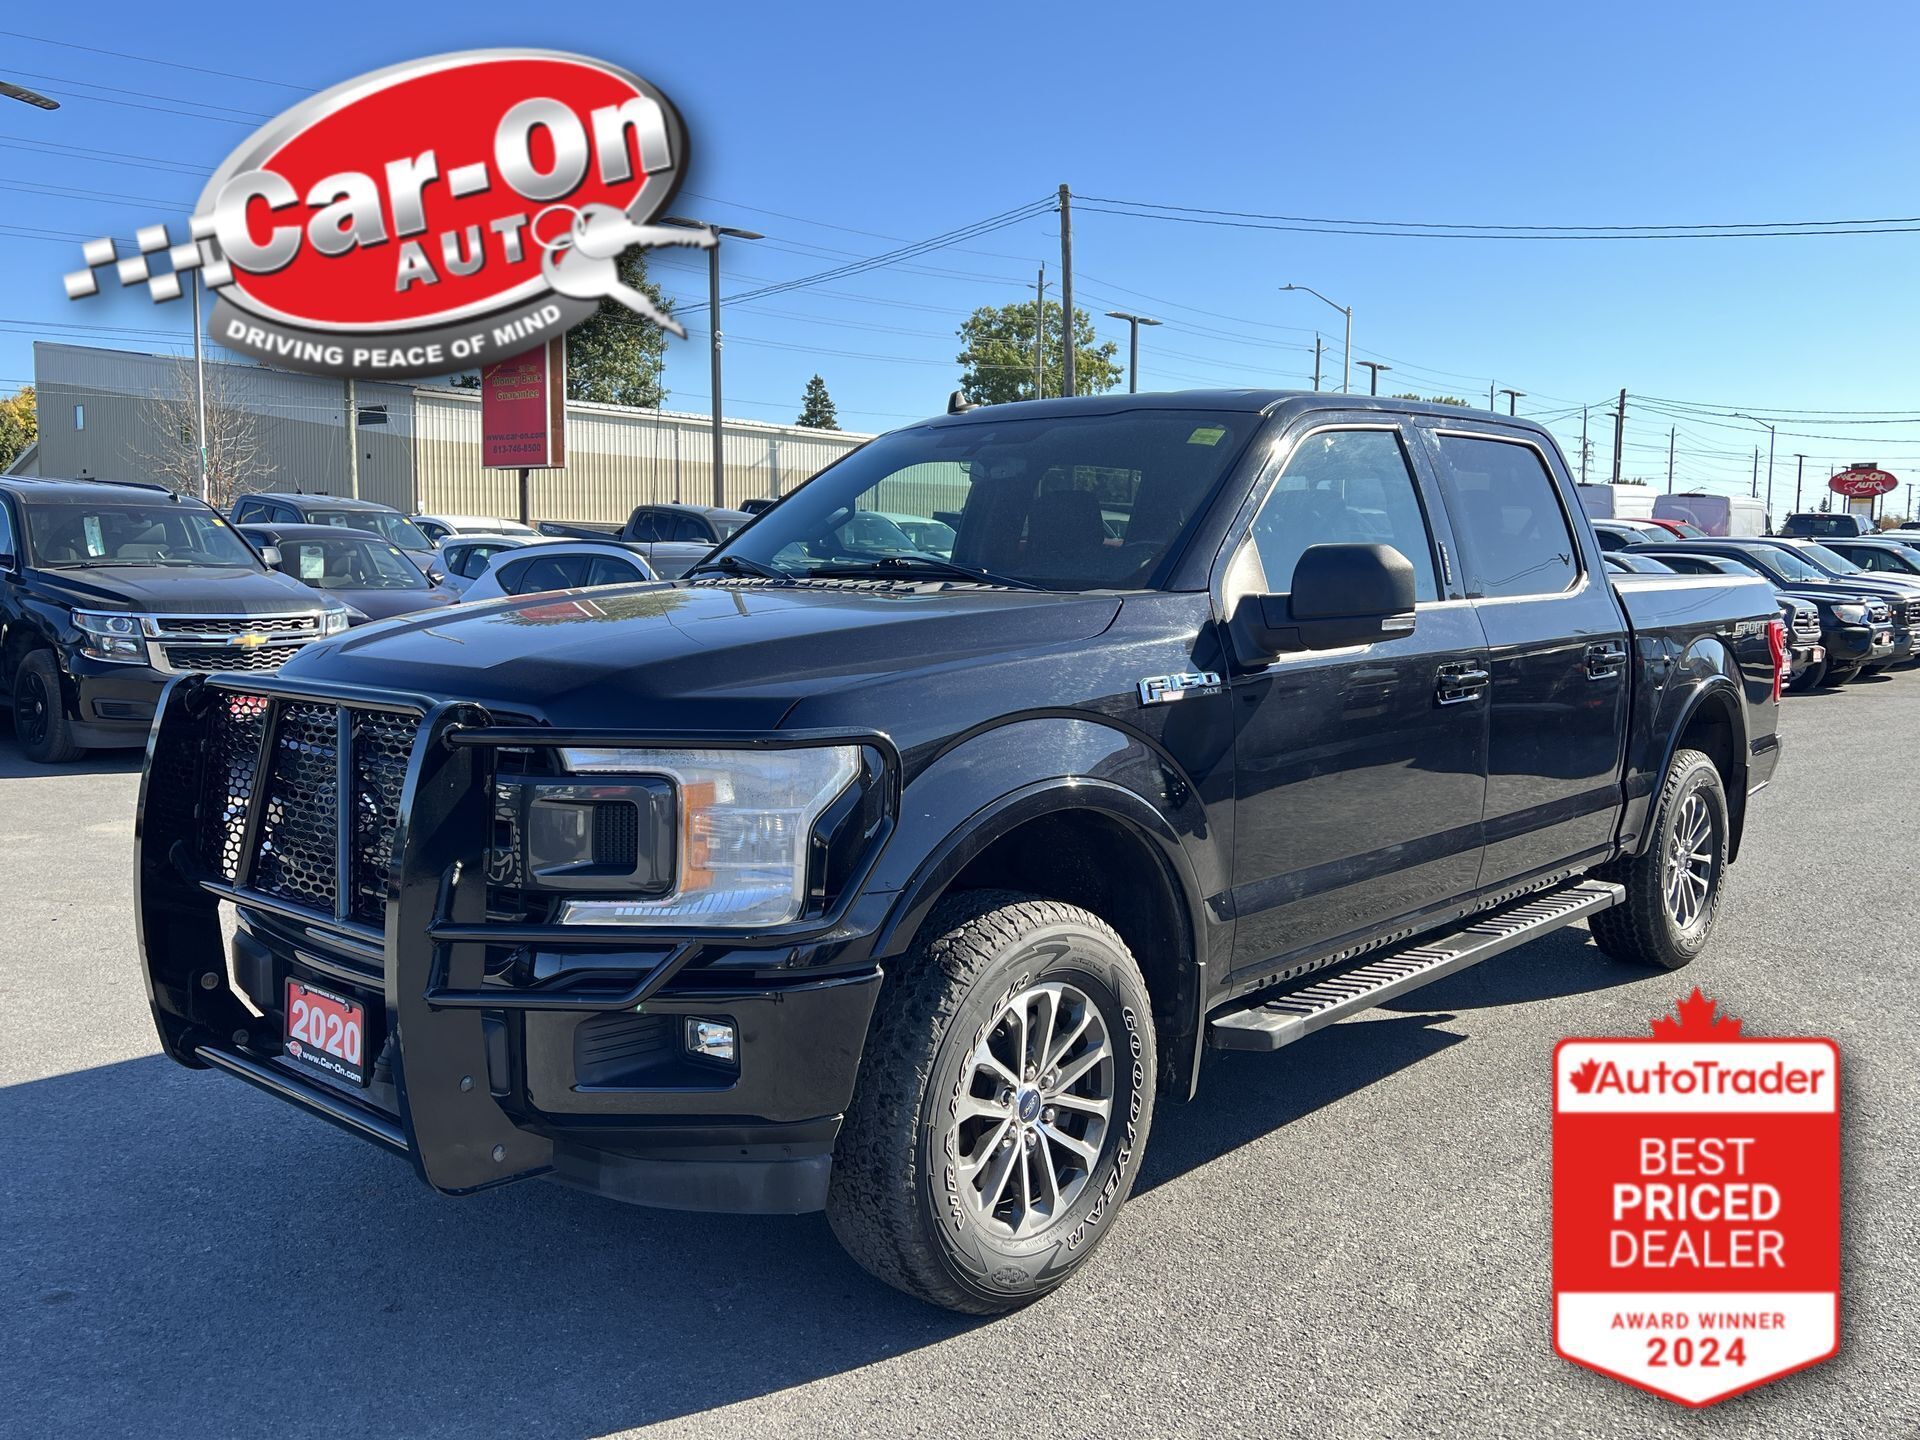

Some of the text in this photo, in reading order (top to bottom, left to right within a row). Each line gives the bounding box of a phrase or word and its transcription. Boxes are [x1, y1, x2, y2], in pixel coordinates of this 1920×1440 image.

[496, 389, 540, 401] Guarantee
[291, 999, 361, 1065] 2020
[302, 1051, 362, 1083] www.Car-On.com
[1067, 1006, 1145, 1250] GOODYEAR
